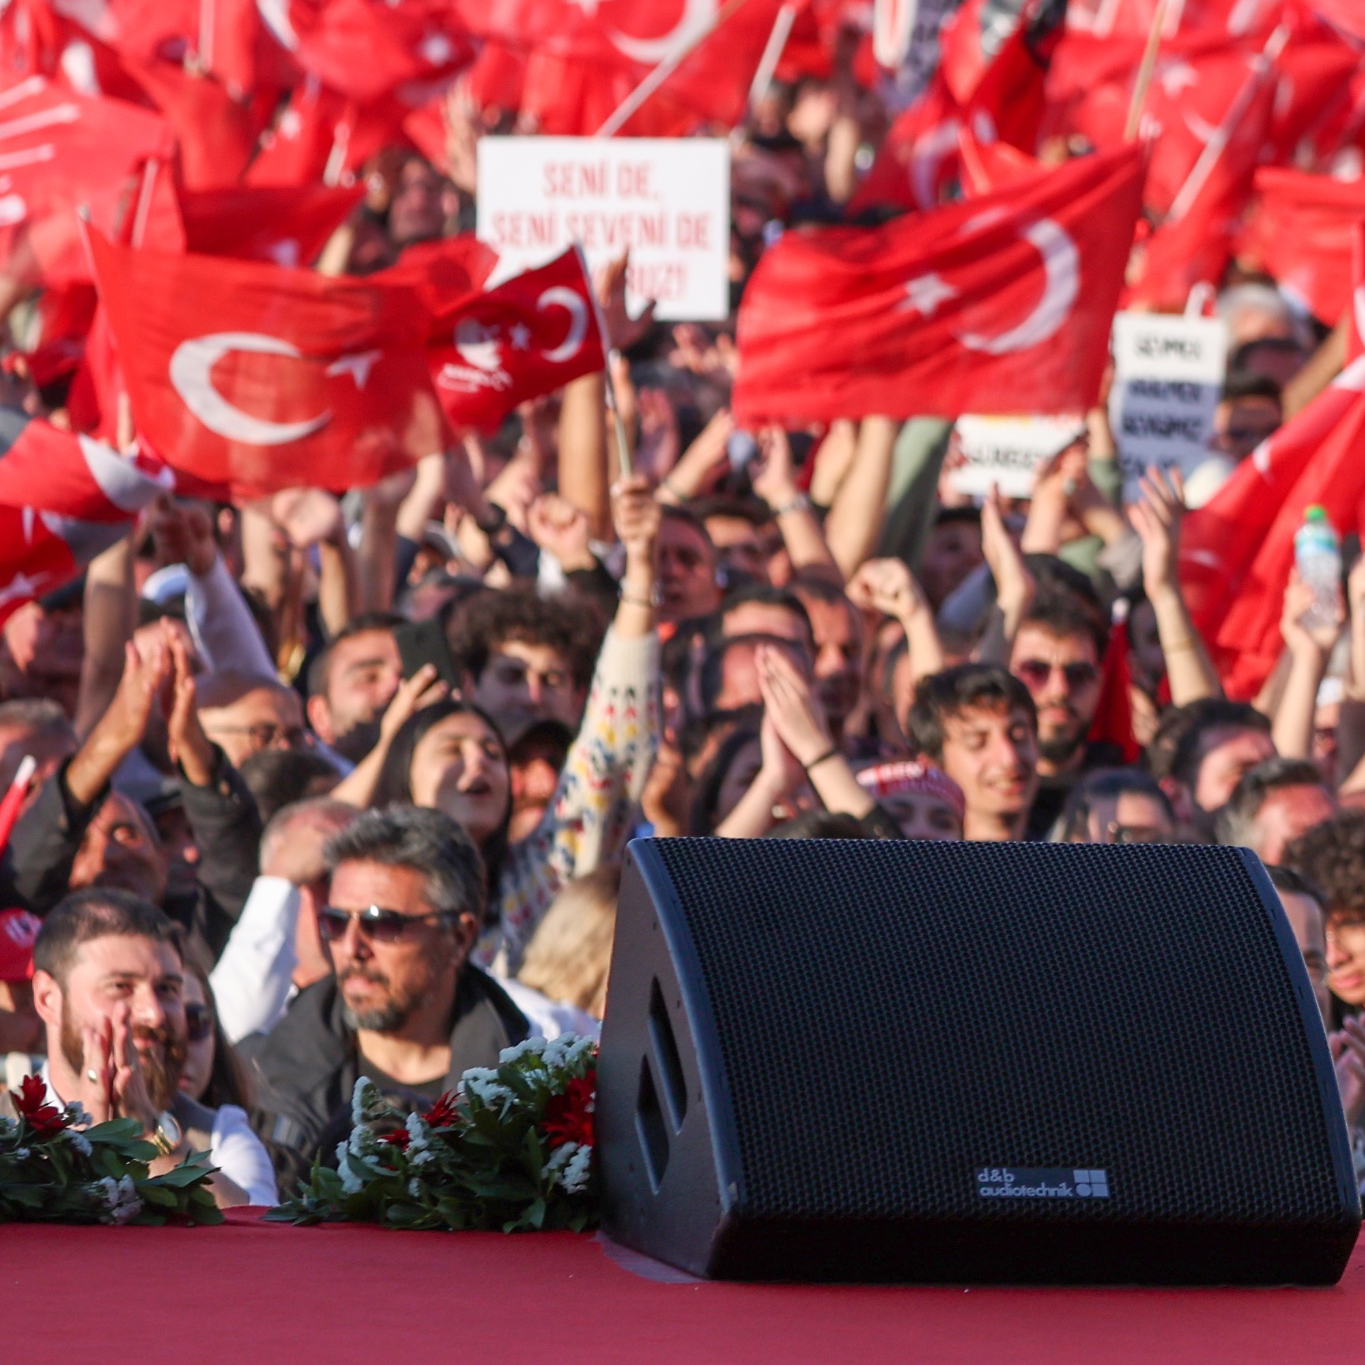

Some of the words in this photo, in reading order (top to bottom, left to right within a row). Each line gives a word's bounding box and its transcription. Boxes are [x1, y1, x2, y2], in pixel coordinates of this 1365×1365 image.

[543, 157, 606, 197] SENİ
[492, 209, 557, 247] SENİ
[566, 209, 666, 249] SEVENİ
[675, 212, 711, 250] DE
[977, 1168, 1015, 1183] d&b
[979, 1182, 1074, 1197] audiotechnik
